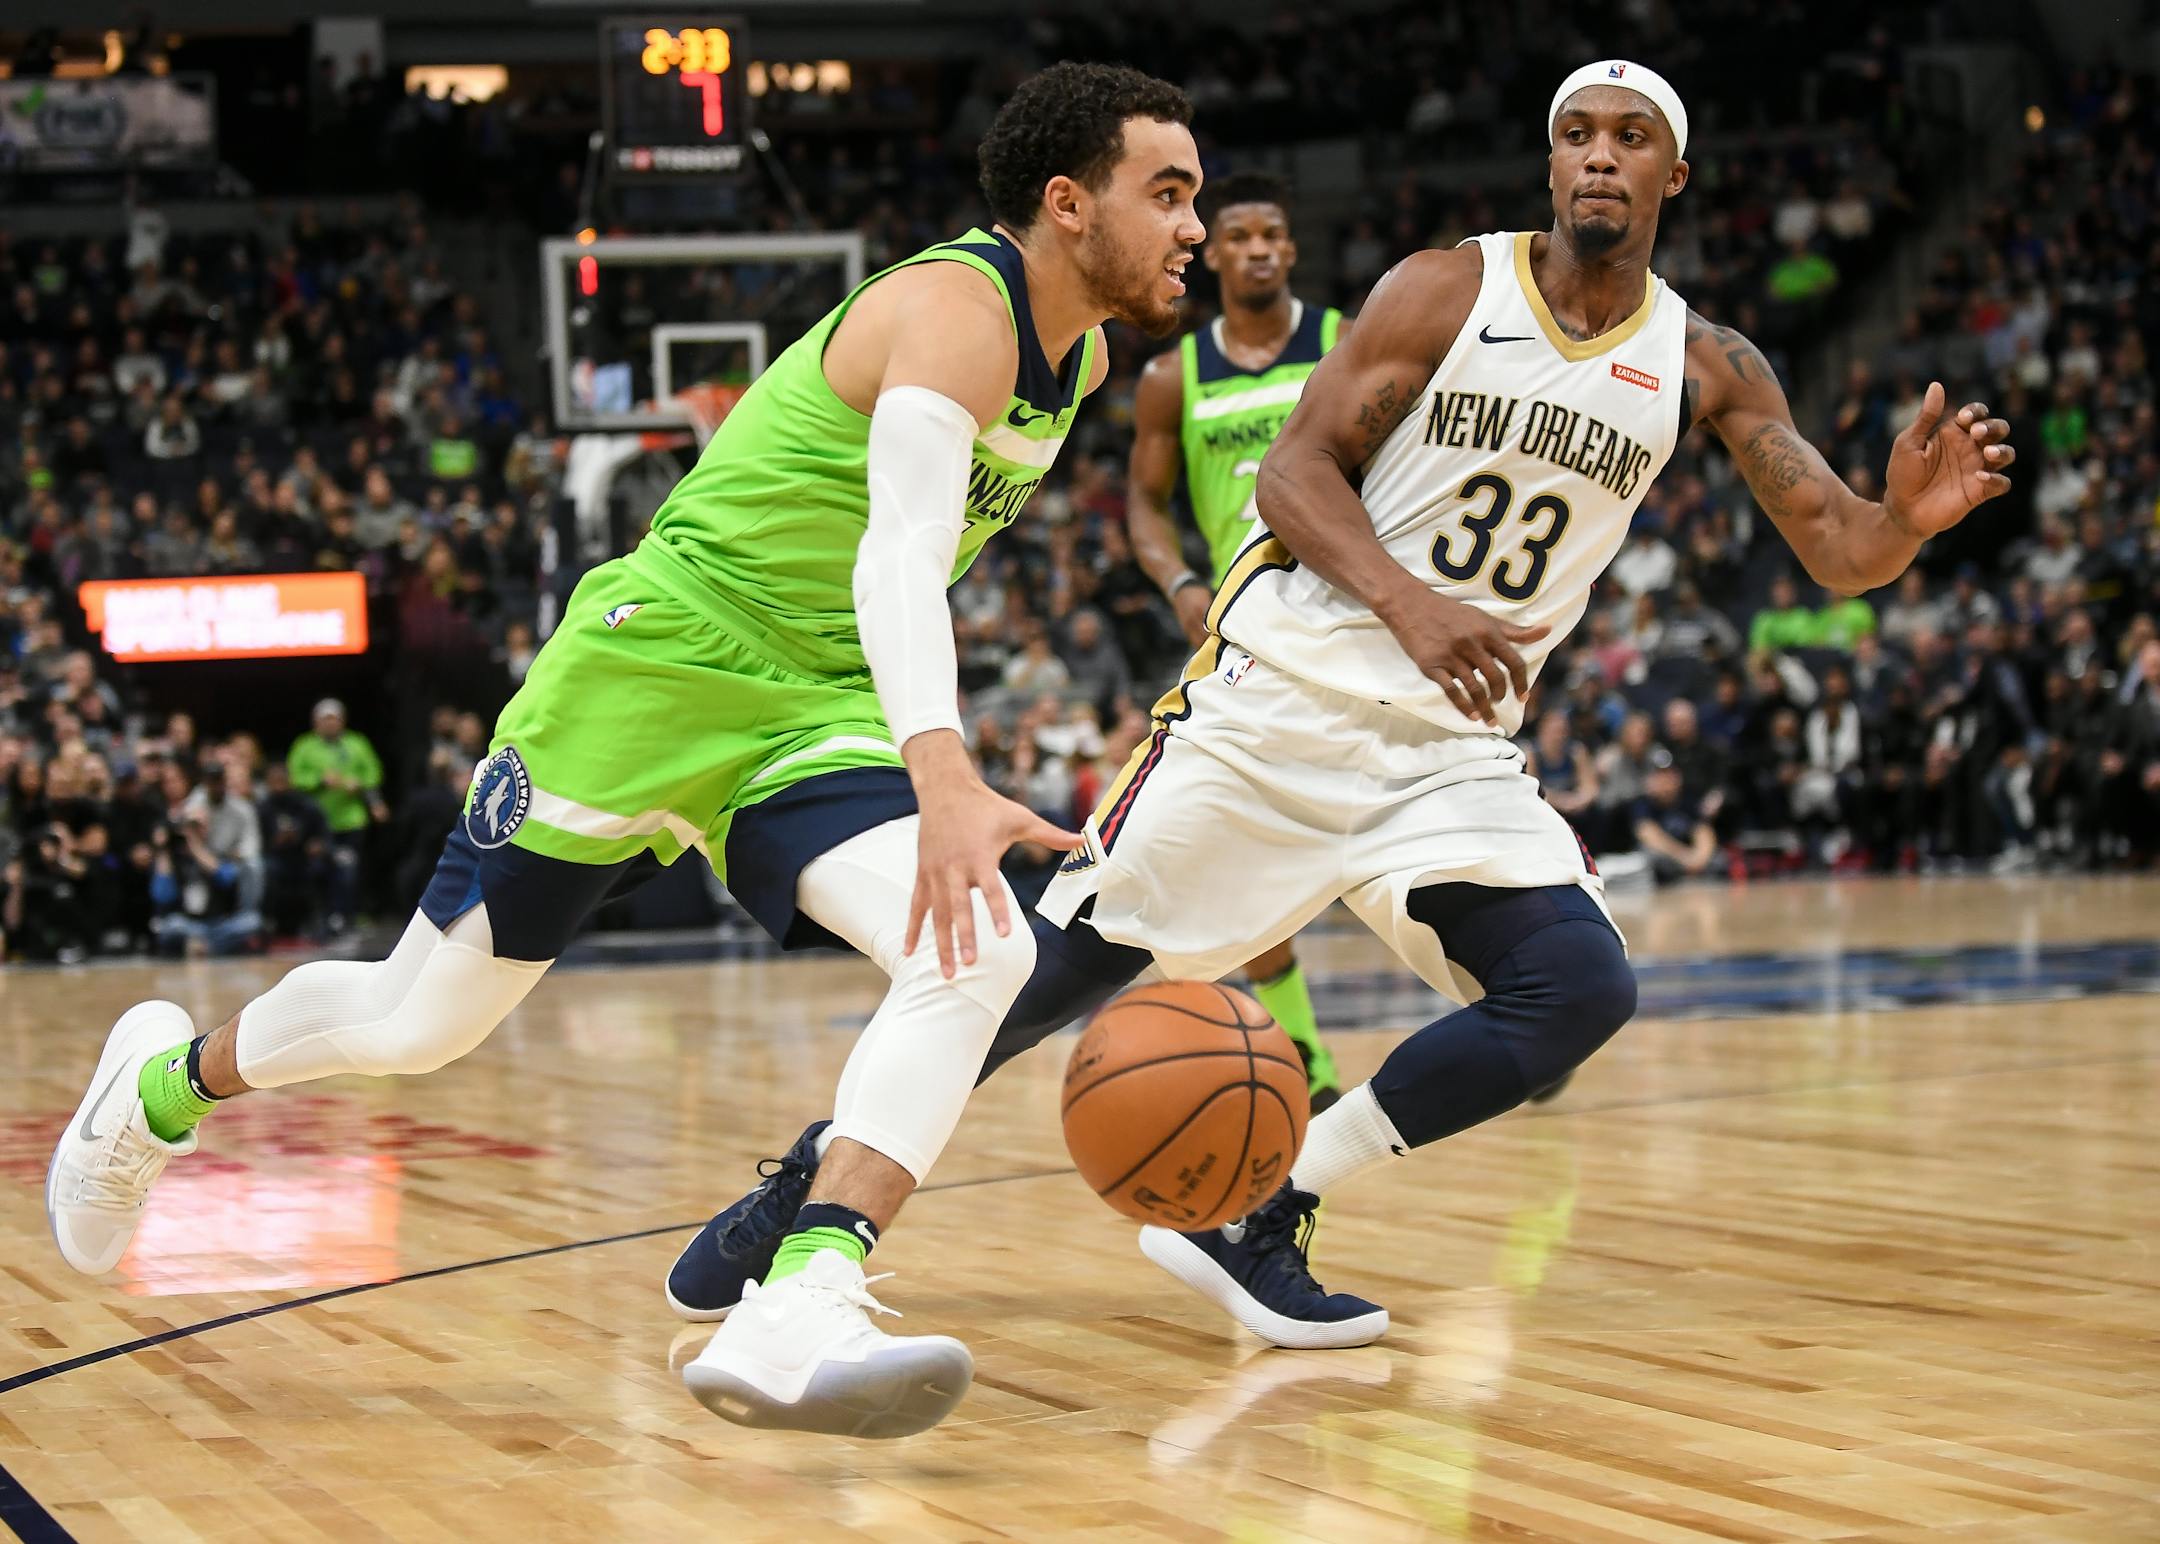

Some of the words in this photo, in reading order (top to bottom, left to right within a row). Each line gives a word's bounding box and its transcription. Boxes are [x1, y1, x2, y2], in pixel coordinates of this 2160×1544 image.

[642, 28, 730, 74] 2:33
[680, 71, 723, 136] 7
[1424, 391, 1519, 452] NEW
[1520, 401, 1651, 500] ORLEANS
[1428, 470, 1572, 604] 33
